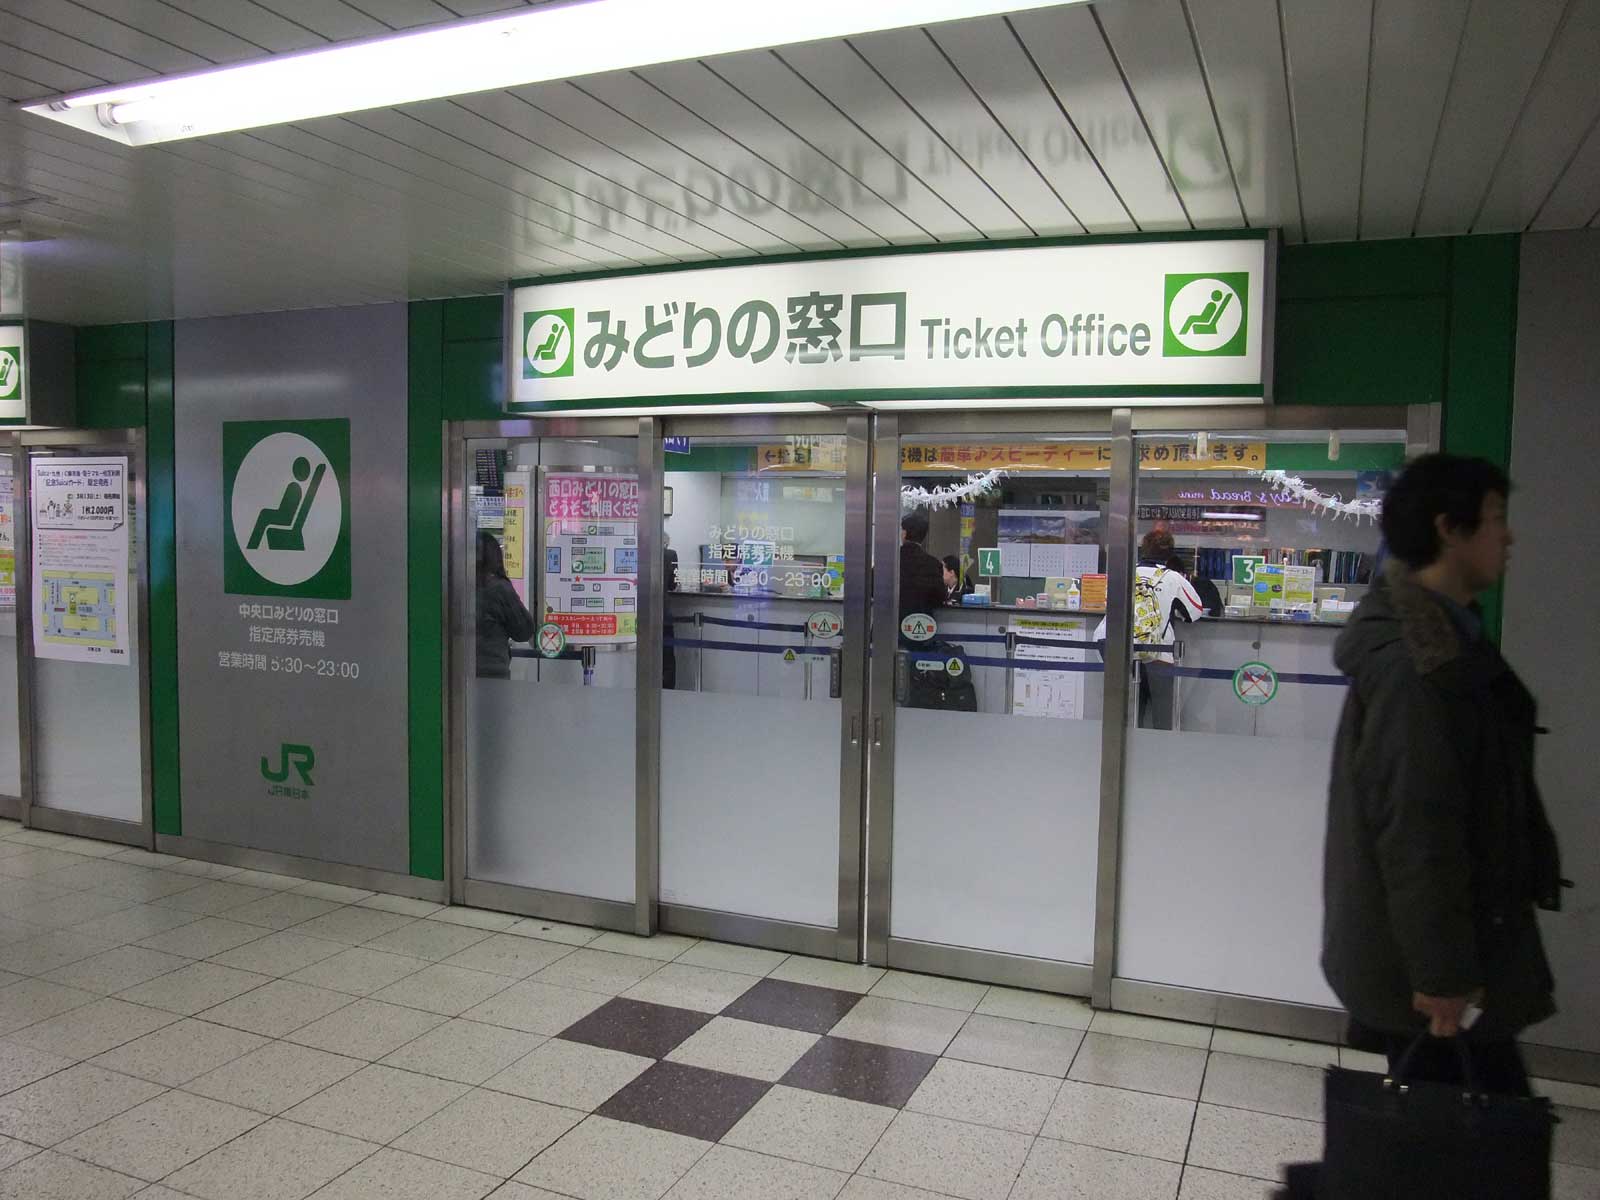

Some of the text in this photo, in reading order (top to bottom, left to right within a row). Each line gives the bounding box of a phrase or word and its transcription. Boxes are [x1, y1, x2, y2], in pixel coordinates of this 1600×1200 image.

[583, 291, 907, 373] みどりの窓口
[920, 313, 1151, 360] Ticket Office
[1139, 443, 1258, 462] 求め頂ます。
[708, 526, 795, 541] みどりの窓口
[708, 544, 796, 561] 指定席券売機
[986, 551, 995, 574] 4
[673, 568, 729, 586] 営業時間
[1243, 559, 1254, 584] 3
[239, 604, 339, 624] 中央口みどりの窓口
[248, 625, 325, 648] 指定席券売機
[218, 651, 267, 671] 営業時間
[261, 743, 315, 786] JR
